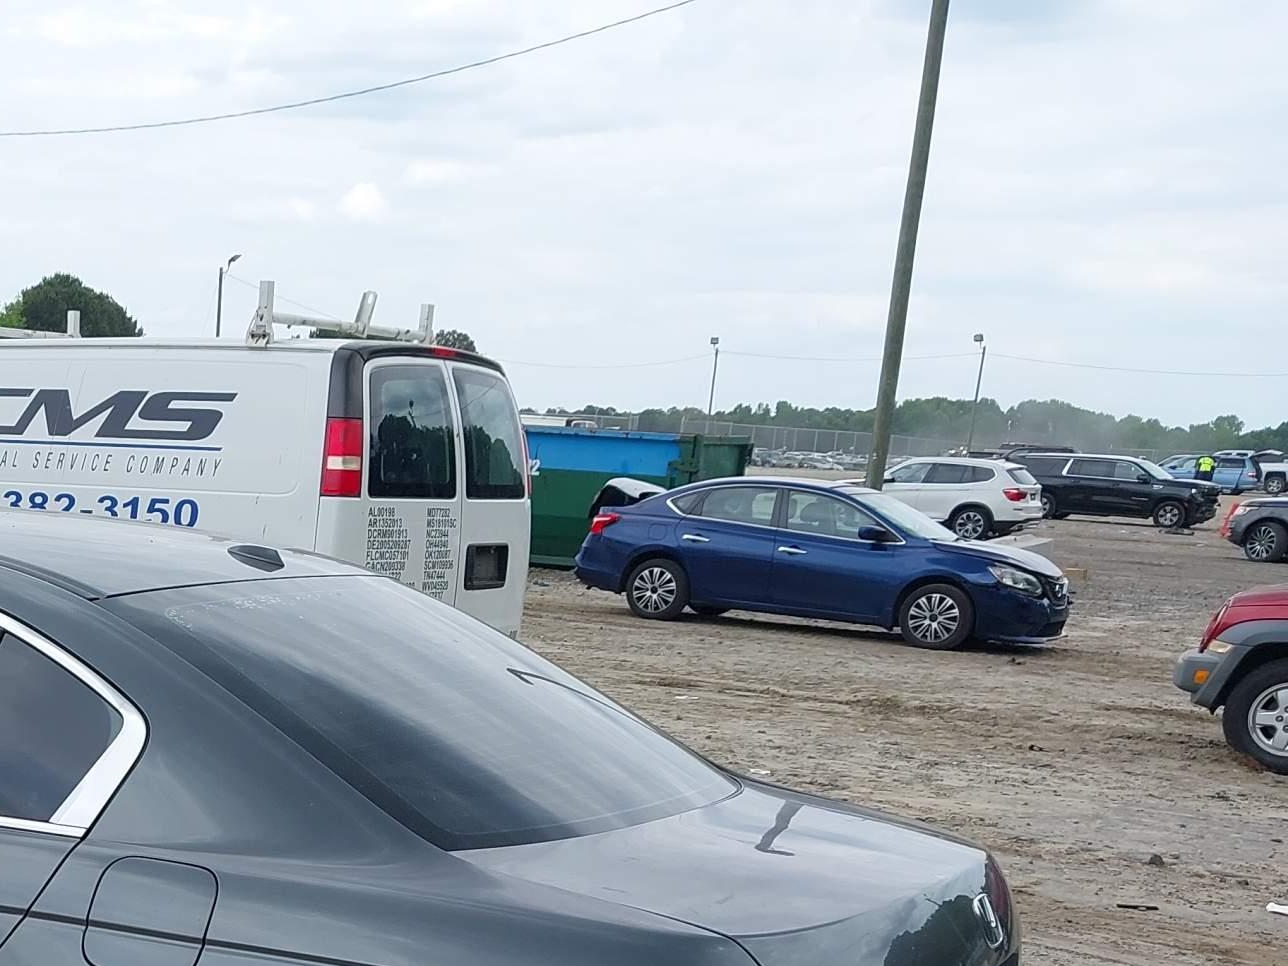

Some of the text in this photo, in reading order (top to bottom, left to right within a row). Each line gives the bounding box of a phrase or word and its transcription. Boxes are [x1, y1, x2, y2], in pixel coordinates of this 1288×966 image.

[32, 450, 112, 472] SERVICE
[126, 454, 223, 477] COMPANY
[3, 490, 199, 528] 382-3150
